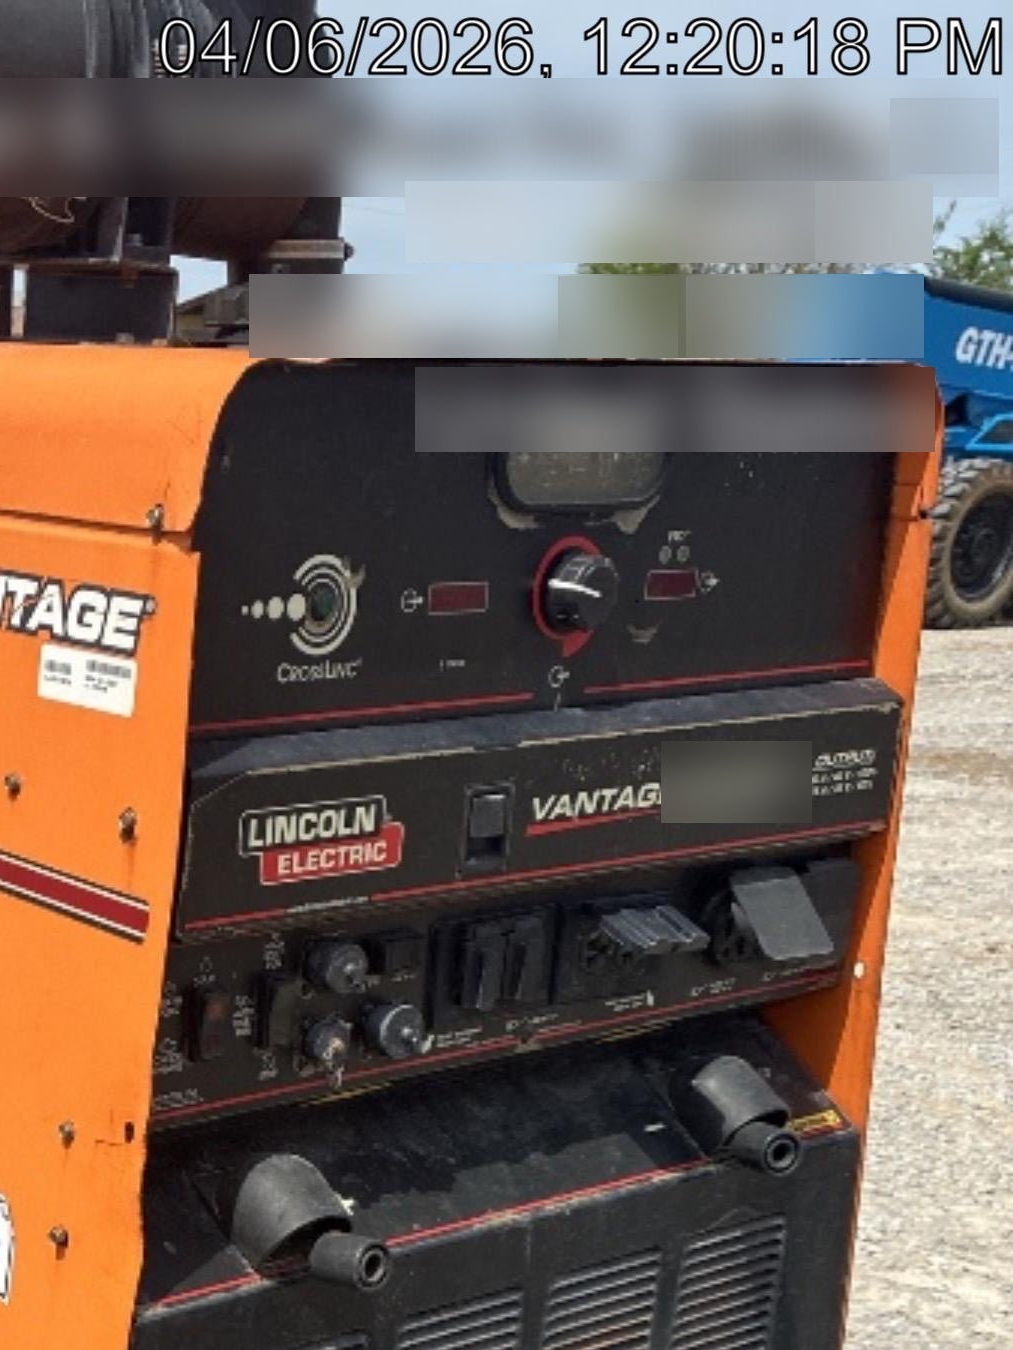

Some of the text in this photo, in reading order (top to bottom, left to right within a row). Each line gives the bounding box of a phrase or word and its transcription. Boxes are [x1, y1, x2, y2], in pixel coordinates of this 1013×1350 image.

[955, 326, 1013, 372] GTH-
[531, 781, 662, 821] VANTAG
[247, 803, 376, 849] LINCOLN
[276, 839, 388, 877] ELECTRIC
